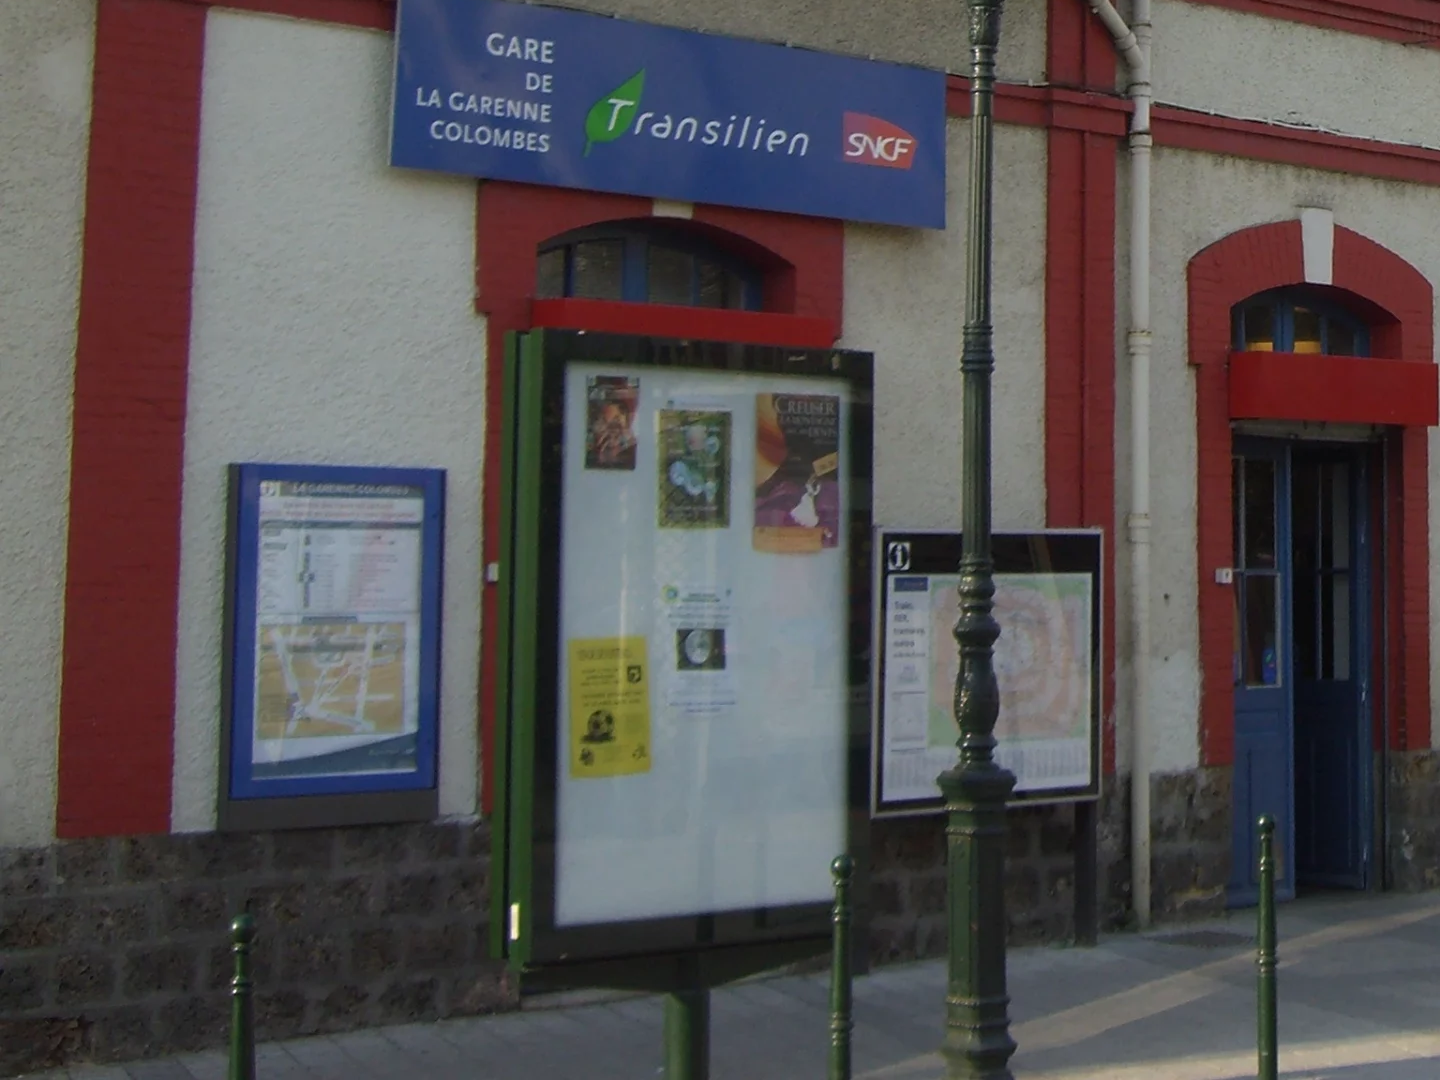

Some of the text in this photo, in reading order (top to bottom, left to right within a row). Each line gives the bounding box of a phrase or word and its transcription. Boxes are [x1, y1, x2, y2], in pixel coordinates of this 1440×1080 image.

[486, 32, 554, 64] GARE
[525, 72, 553, 93] DE
[416, 86, 552, 123] LA GARENNE
[430, 120, 550, 153] COLOMBES
[607, 98, 810, 157] Transilien
[845, 132, 912, 162] SNCF
